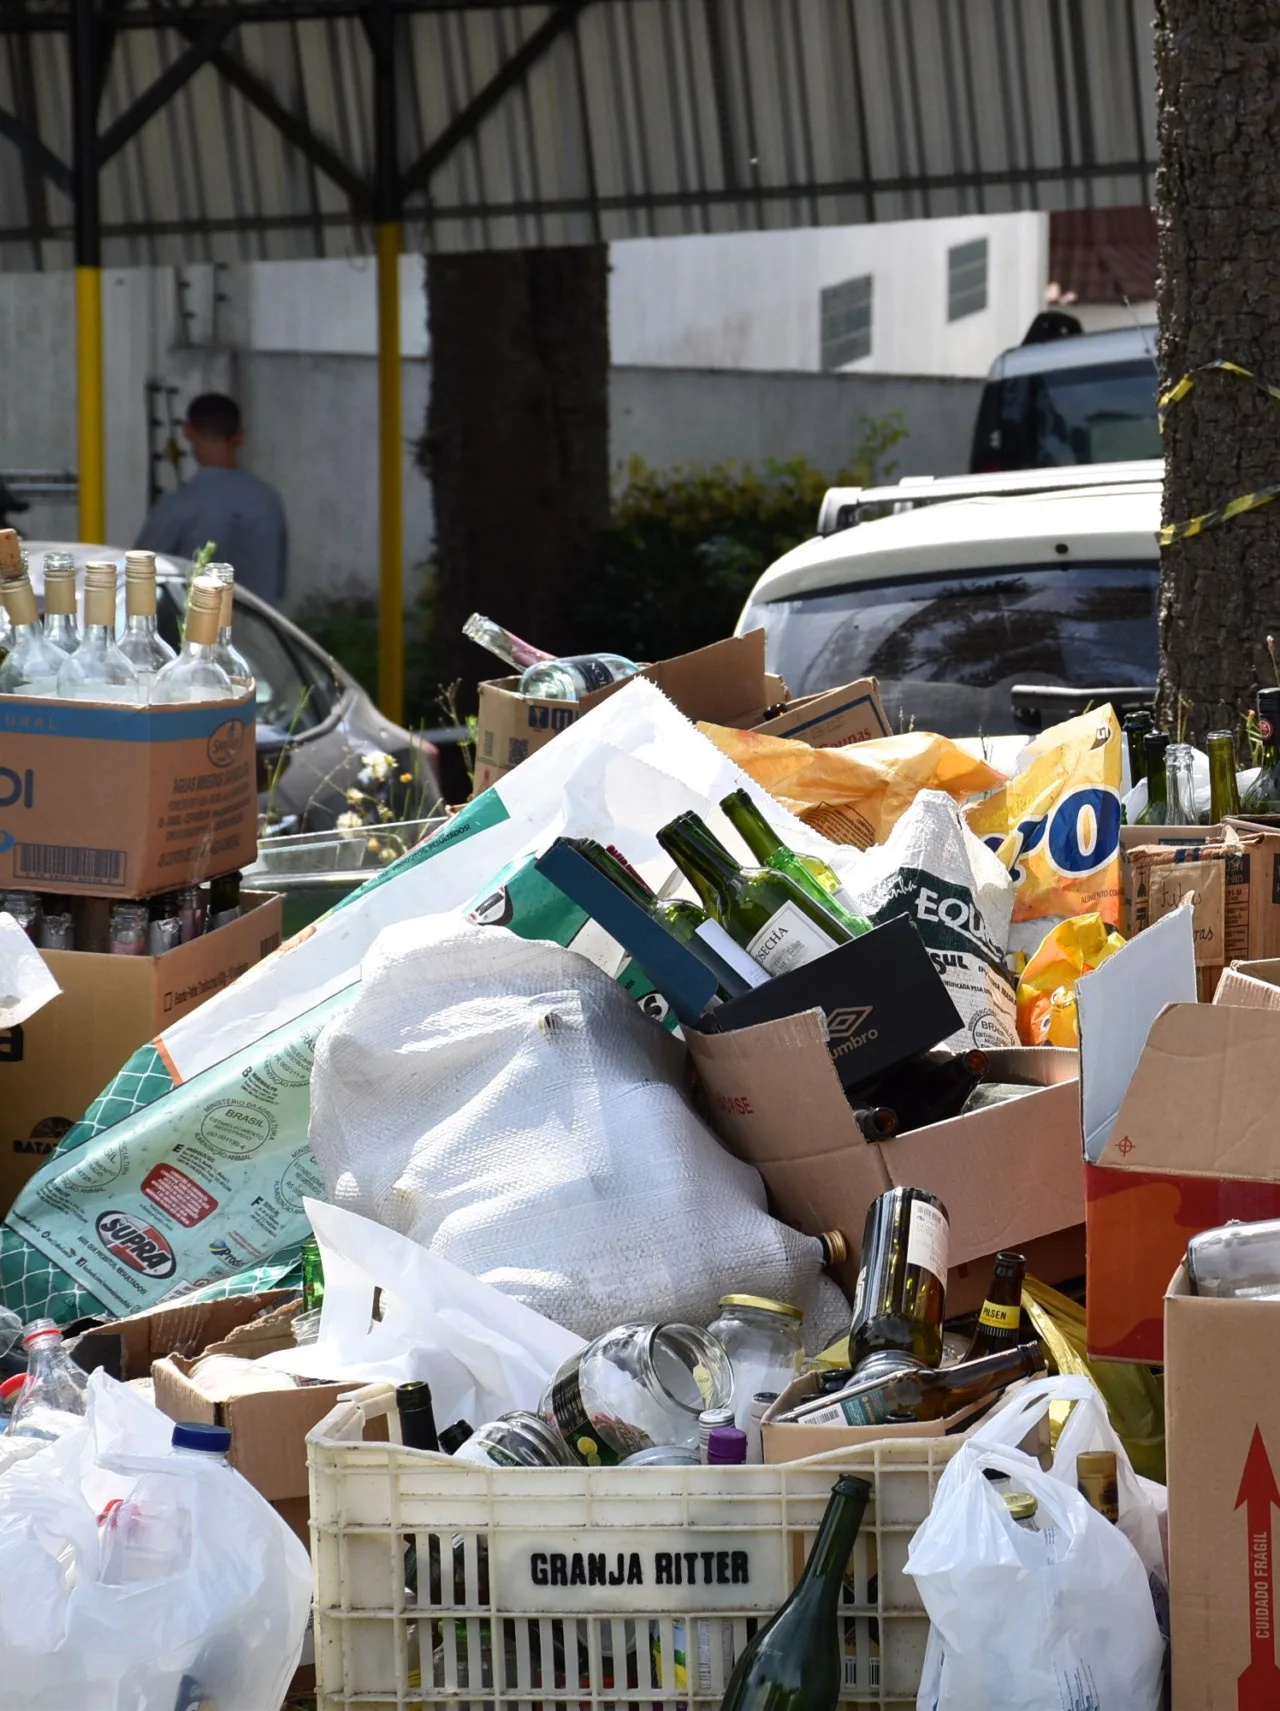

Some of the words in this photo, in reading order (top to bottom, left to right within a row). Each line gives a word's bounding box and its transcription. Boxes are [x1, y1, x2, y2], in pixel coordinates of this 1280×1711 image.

[829, 1028, 879, 1060] umbro
[241, 1065, 252, 1077] B
[225, 1108, 265, 1128] BRASIL
[172, 1143, 184, 1153] E
[251, 1195, 264, 1206] F
[99, 1217, 173, 1270] SUPRA
[982, 1307, 1008, 1321] PILSEN
[1251, 1530, 1269, 1577] FRÁGIL
[530, 1552, 643, 1586] GRANJA
[654, 1550, 750, 1585] RITTER
[1255, 1581, 1270, 1640] CUIDADO
